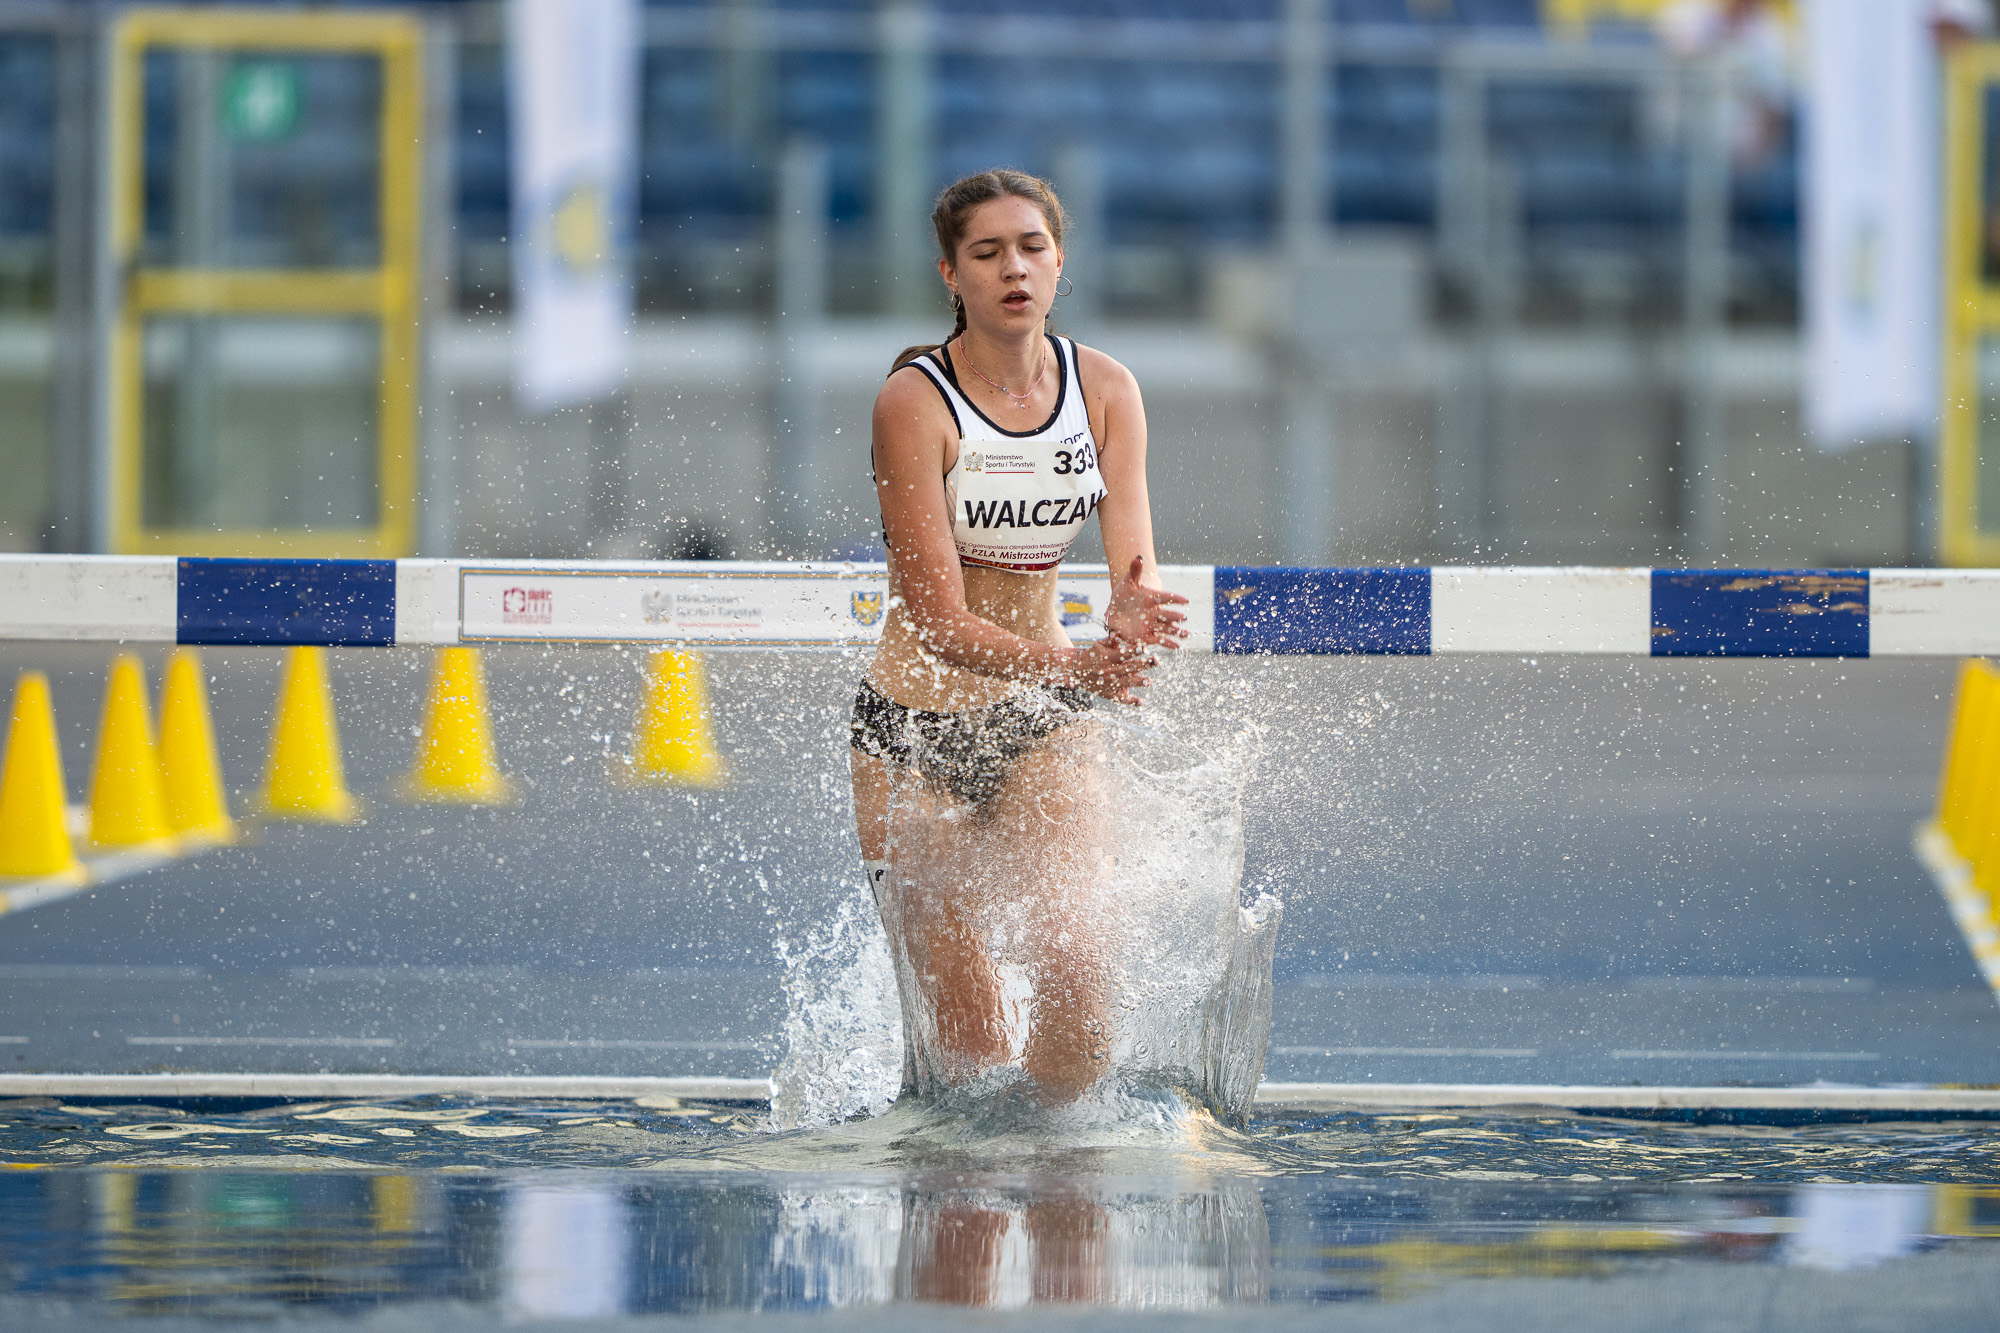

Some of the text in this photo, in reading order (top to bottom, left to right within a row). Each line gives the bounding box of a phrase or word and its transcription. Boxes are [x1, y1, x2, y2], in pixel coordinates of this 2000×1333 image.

[1053, 442, 1094, 475] 333
[985, 461, 1005, 469] Sportu
[971, 549, 996, 558] PZLA
[999, 551, 1058, 560] Mistrzostwa
